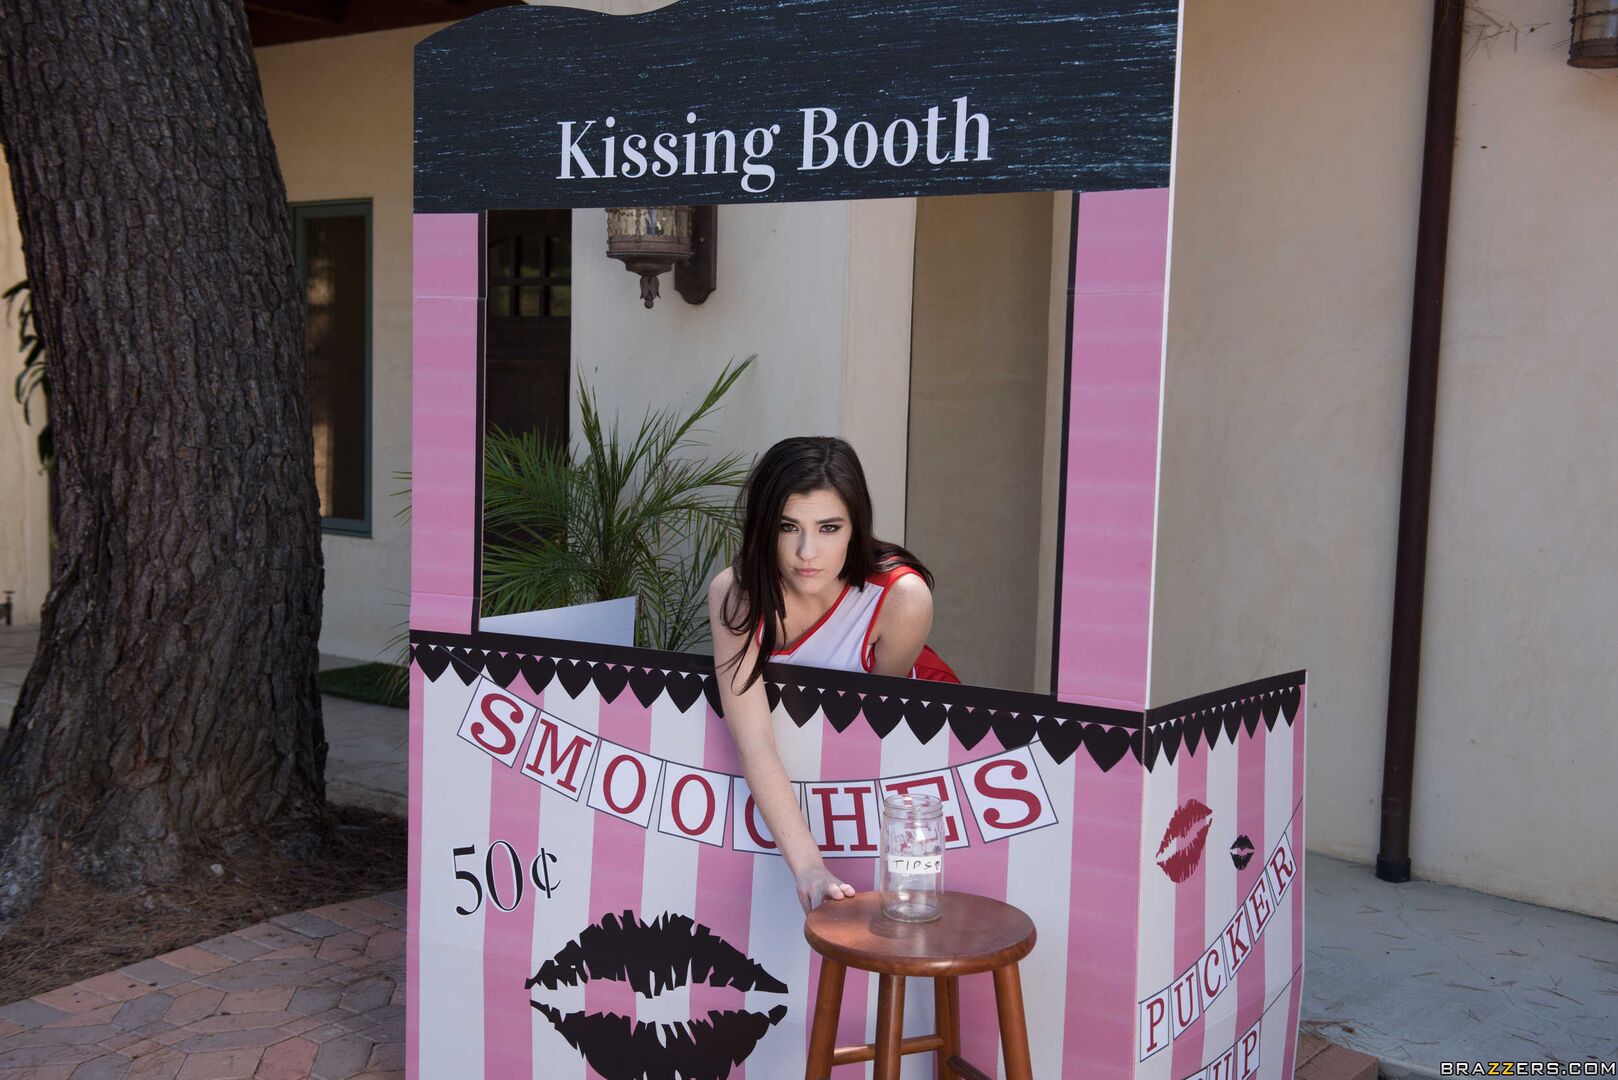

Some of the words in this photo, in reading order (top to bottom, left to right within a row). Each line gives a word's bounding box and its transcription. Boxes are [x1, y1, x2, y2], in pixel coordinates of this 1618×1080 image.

[555, 113, 780, 193] Kissing
[797, 96, 992, 172] Booth
[452, 840, 562, 916] 50¢
[1146, 846, 1293, 1053] PUCKER
